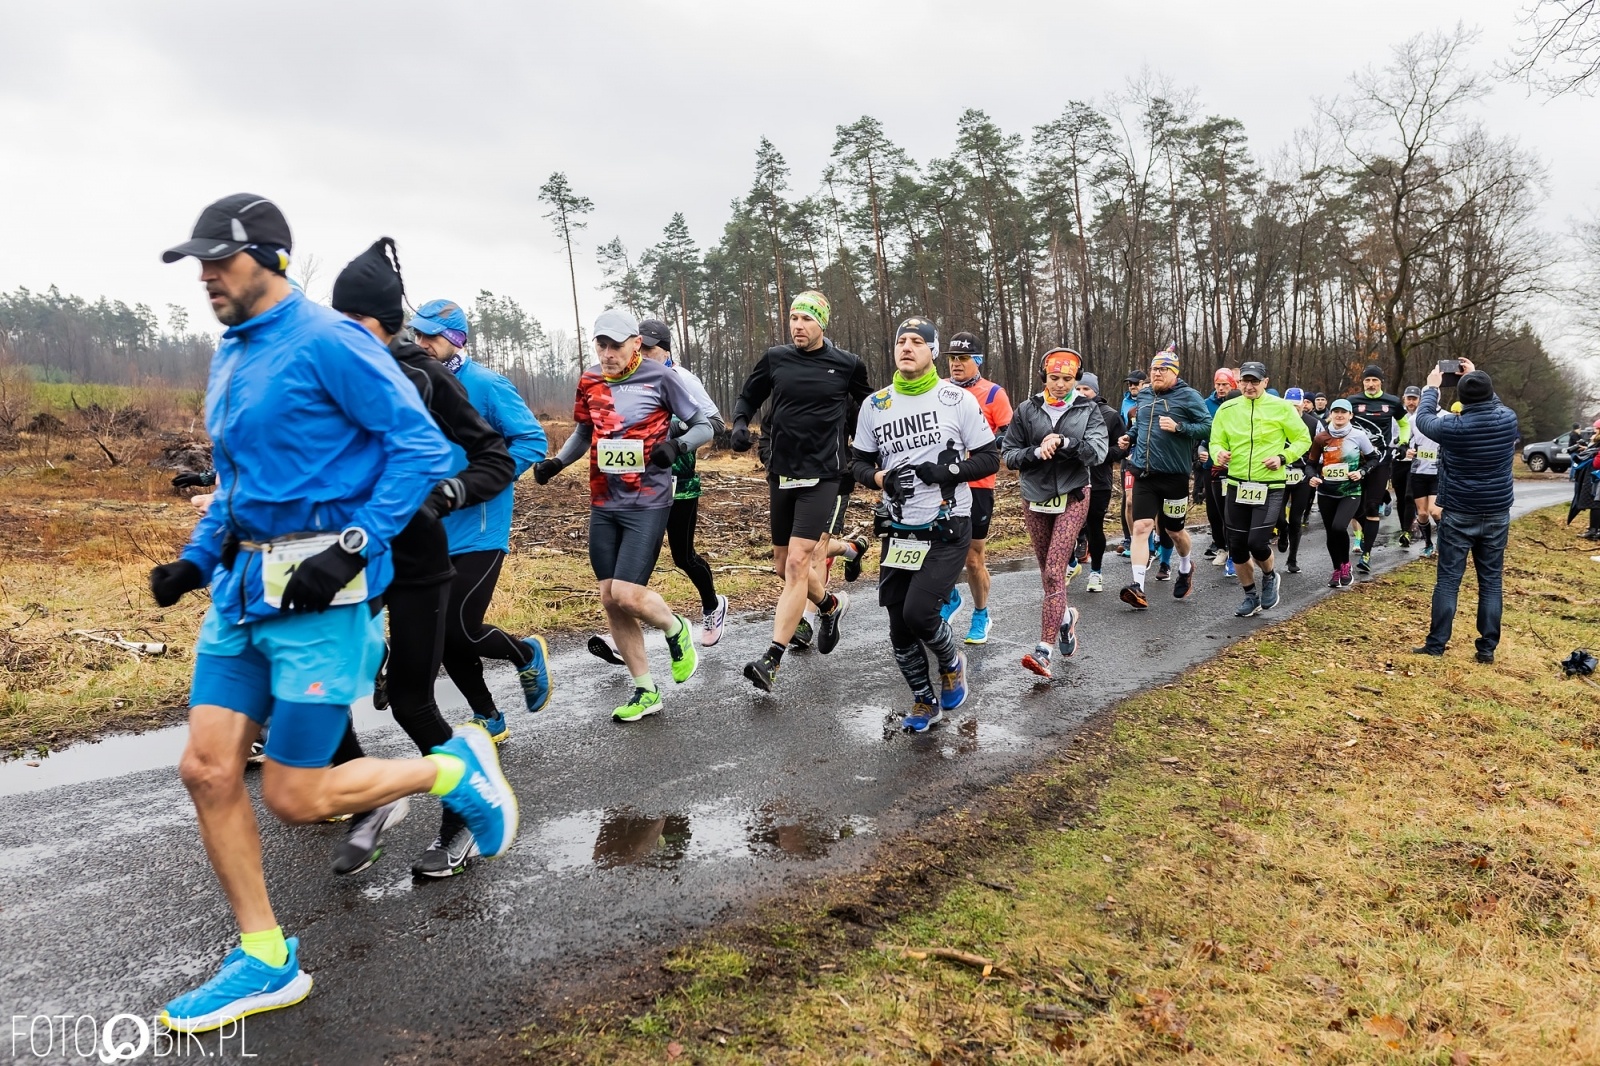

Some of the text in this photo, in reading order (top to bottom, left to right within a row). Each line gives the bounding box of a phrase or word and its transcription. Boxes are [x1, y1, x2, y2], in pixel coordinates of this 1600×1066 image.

[891, 441, 905, 454] JO
[906, 432, 942, 450] LECA?
[605, 451, 637, 467] 243
[1327, 469, 1345, 478] 255
[1241, 489, 1262, 501] 214
[1168, 505, 1185, 515] 186
[894, 550, 921, 564] 159
